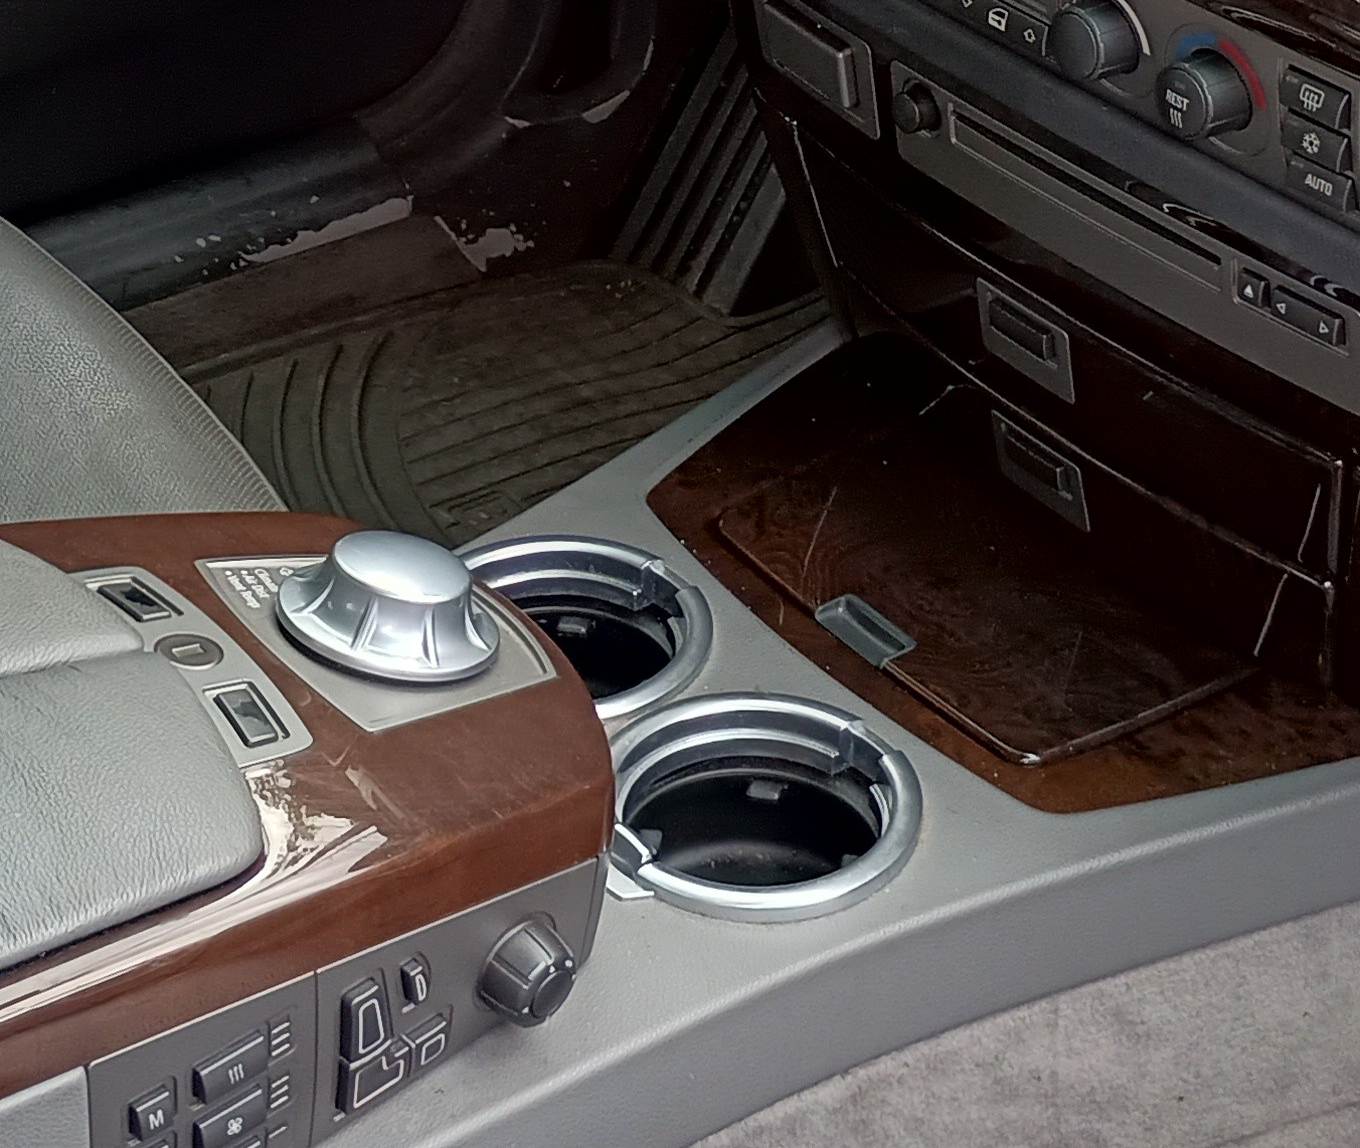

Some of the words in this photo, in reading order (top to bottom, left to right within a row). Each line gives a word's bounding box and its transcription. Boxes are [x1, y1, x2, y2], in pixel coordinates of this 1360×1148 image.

[1165, 88, 1190, 111] REST
[1305, 173, 1333, 196] AUTO
[148, 1109, 165, 1130] M
